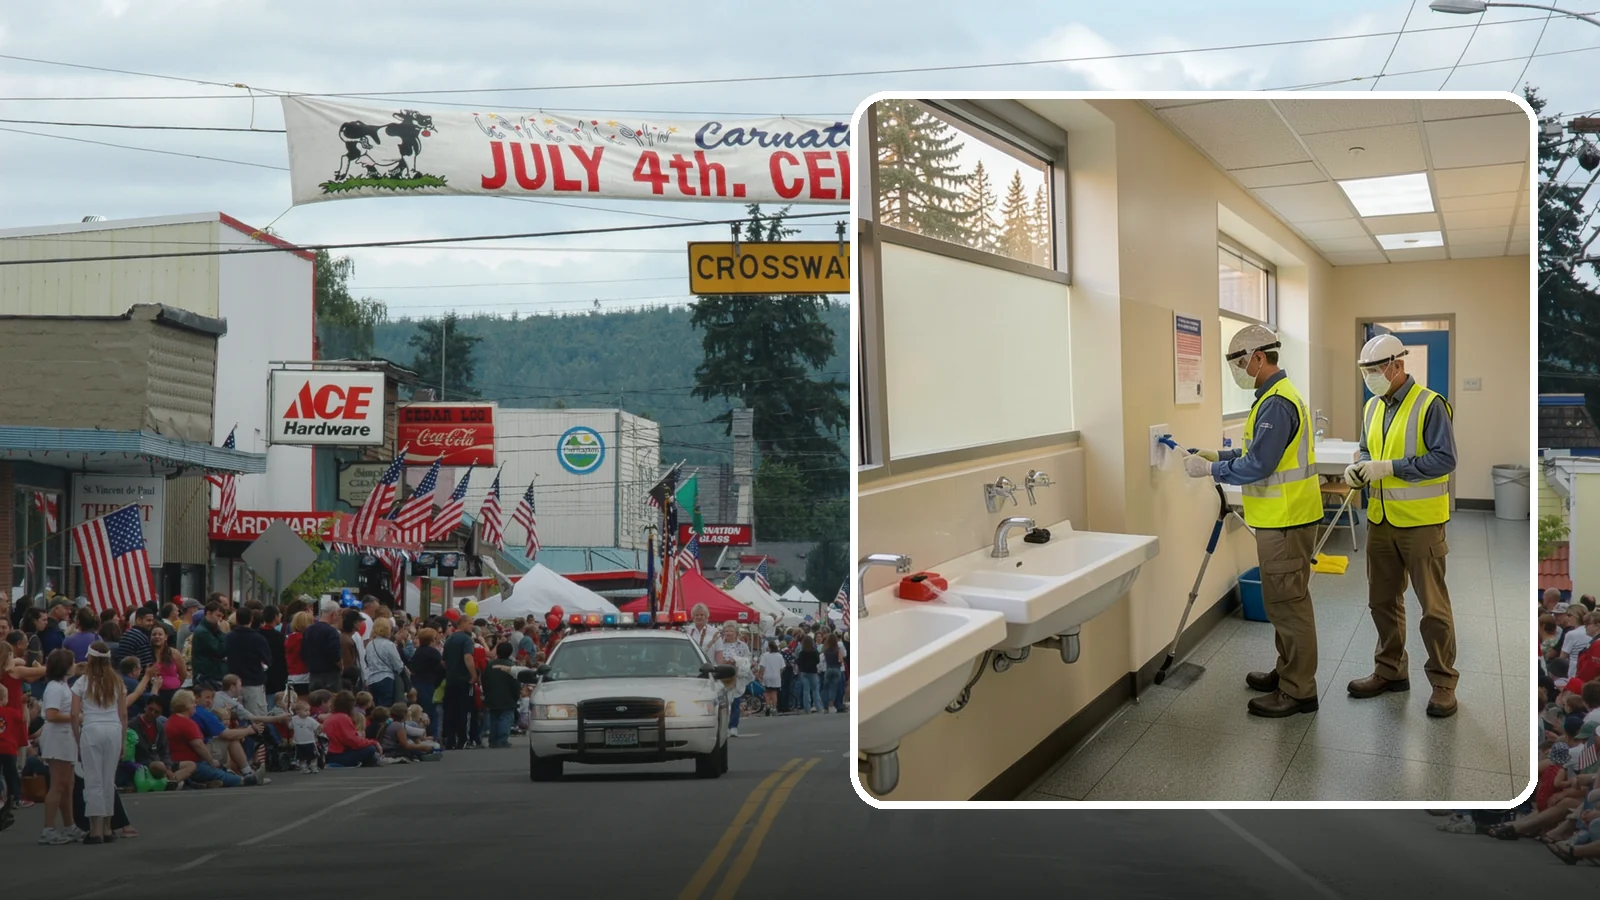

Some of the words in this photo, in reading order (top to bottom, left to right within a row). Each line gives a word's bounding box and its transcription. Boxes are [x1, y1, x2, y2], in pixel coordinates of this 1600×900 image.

[695, 121, 850, 150] Carnat
[481, 141, 605, 192] JULY
[632, 150, 746, 197] 4th.
[697, 254, 850, 280] CROSSWA
[283, 380, 373, 419] ACE
[406, 409, 452, 422] CEDAR
[284, 421, 370, 436] Hardware
[416, 428, 476, 447] Coca-Cola
[96, 485, 124, 494] Vincent
[126, 485, 135, 494] de
[137, 485, 155, 495] Paul
[213, 516, 330, 535] HARDARE
[688, 526, 741, 535] CRNATION
[699, 535, 730, 543] GLASS
